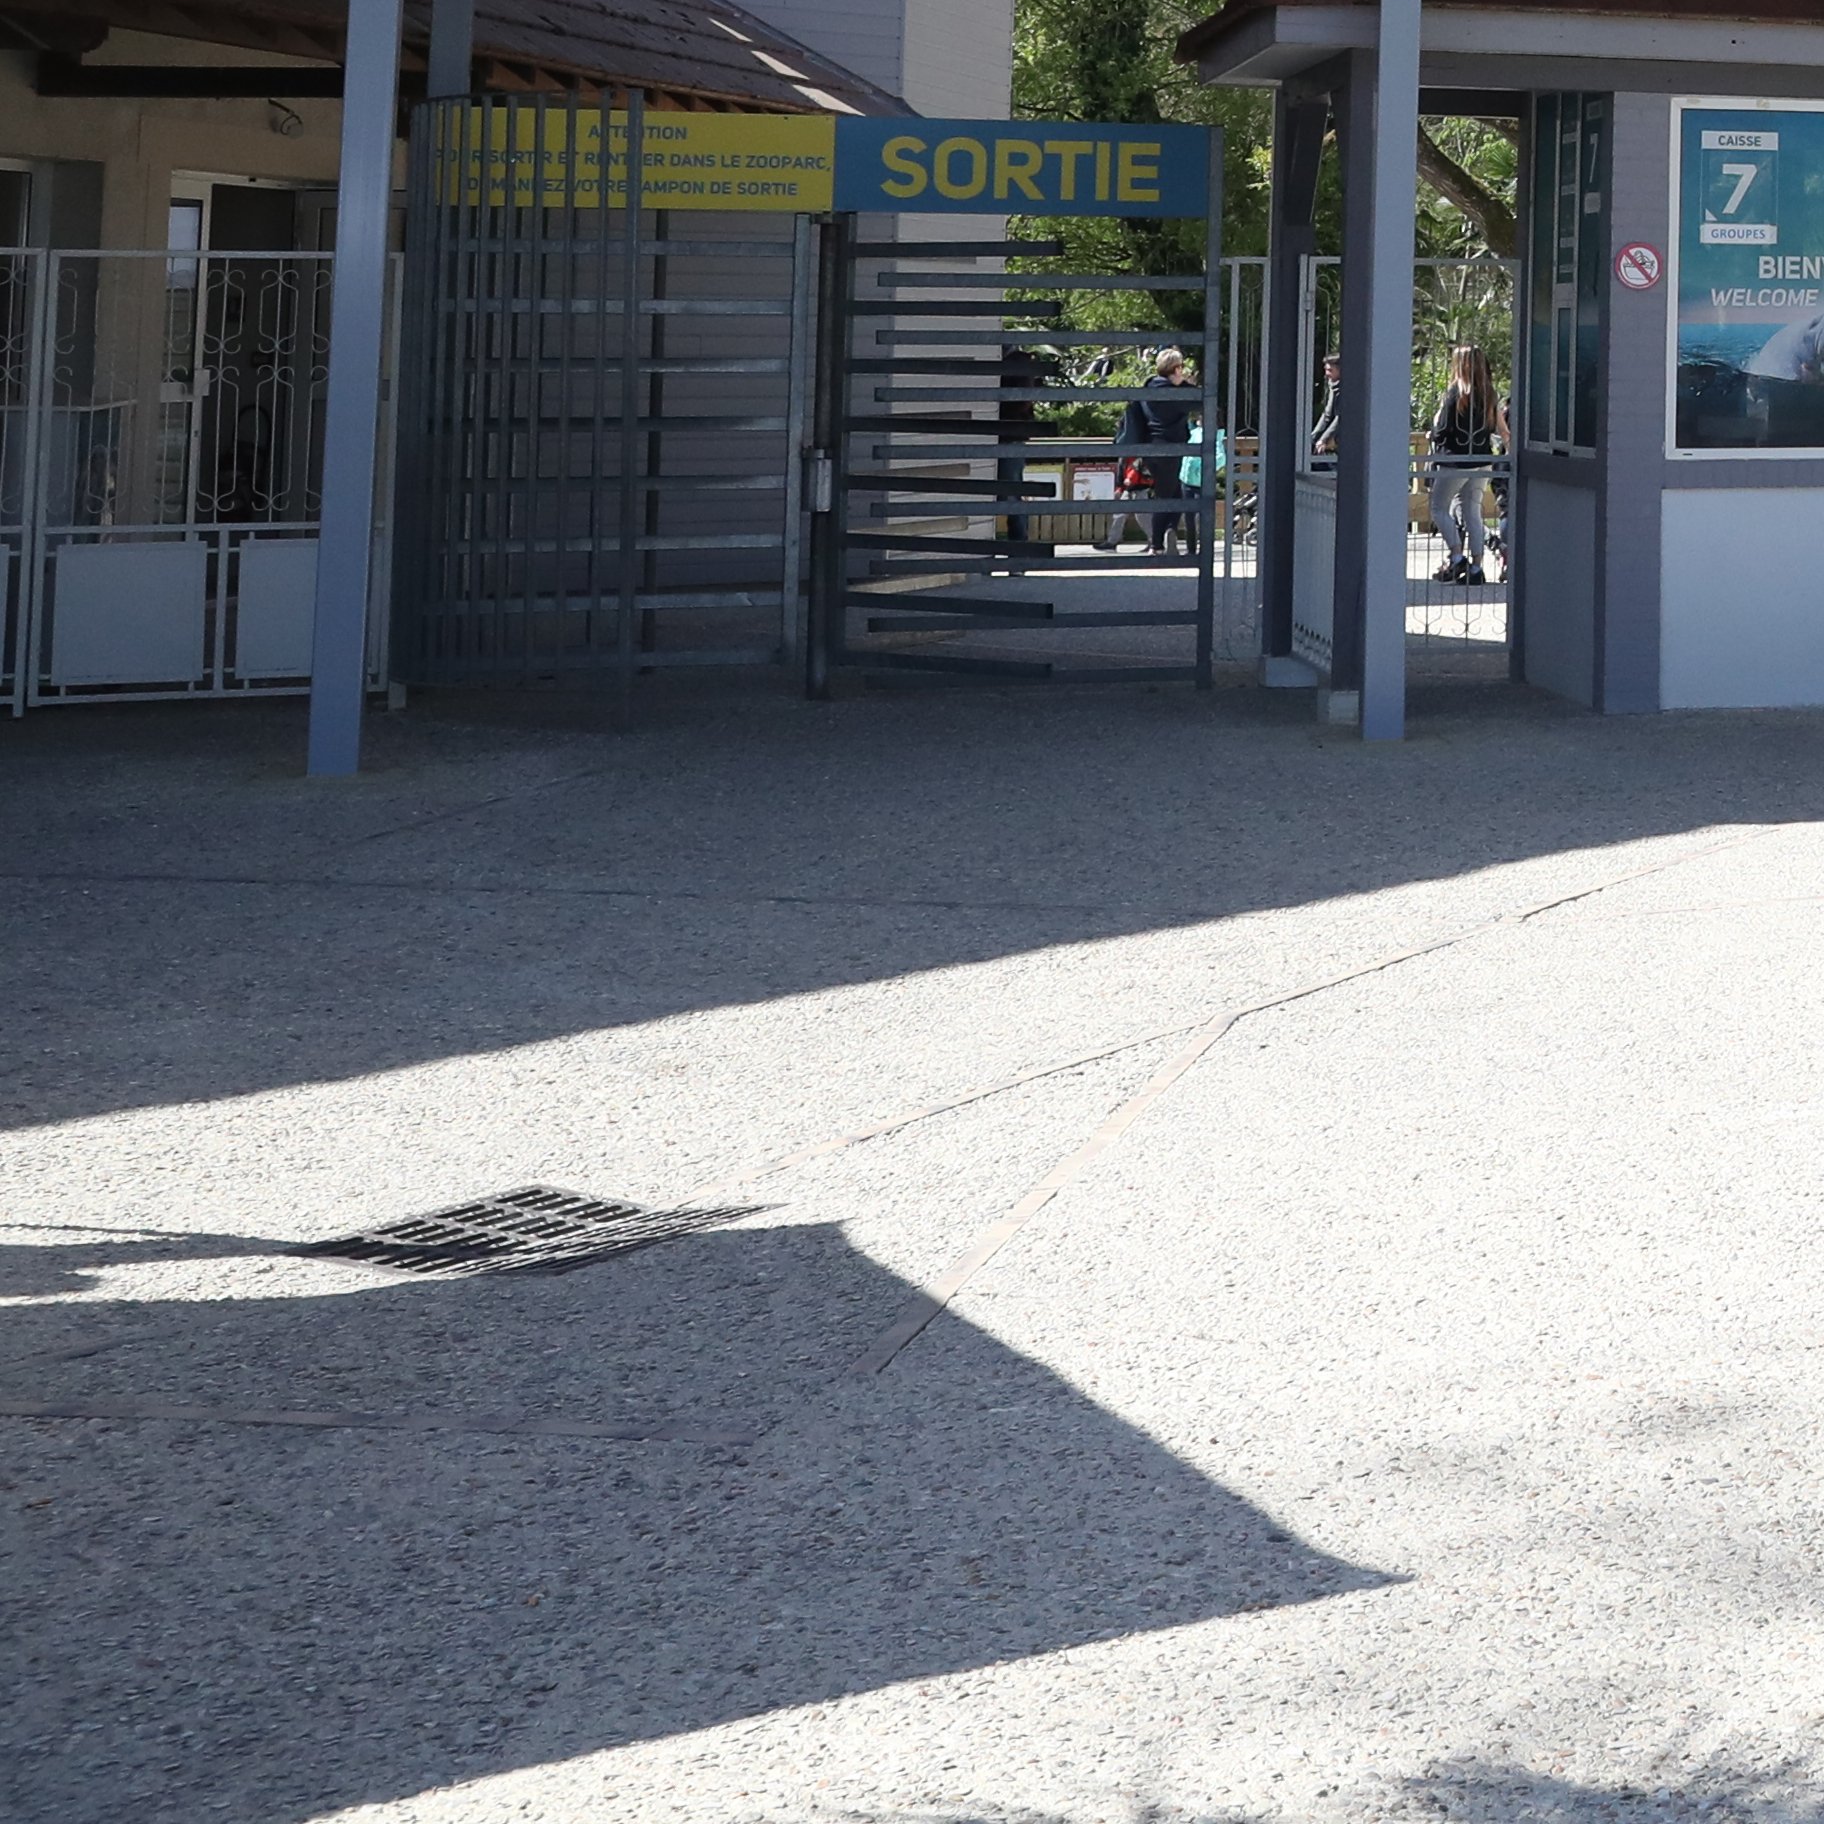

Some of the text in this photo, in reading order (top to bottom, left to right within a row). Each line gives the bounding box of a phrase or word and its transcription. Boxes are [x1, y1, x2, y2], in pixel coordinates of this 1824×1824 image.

[1718, 134, 1762, 147] CAISSE
[670, 153, 716, 168] DANS
[721, 155, 741, 168] LE
[746, 155, 831, 172] ZOOPARC,
[880, 135, 1161, 202] SORTIE
[634, 180, 704, 195] AMPON
[710, 181, 732, 195] DE
[738, 181, 798, 197] SORTIE
[1722, 162, 1758, 215] 7
[1711, 228, 1766, 241] GROUPES
[1711, 288, 1819, 307] WELCOME
